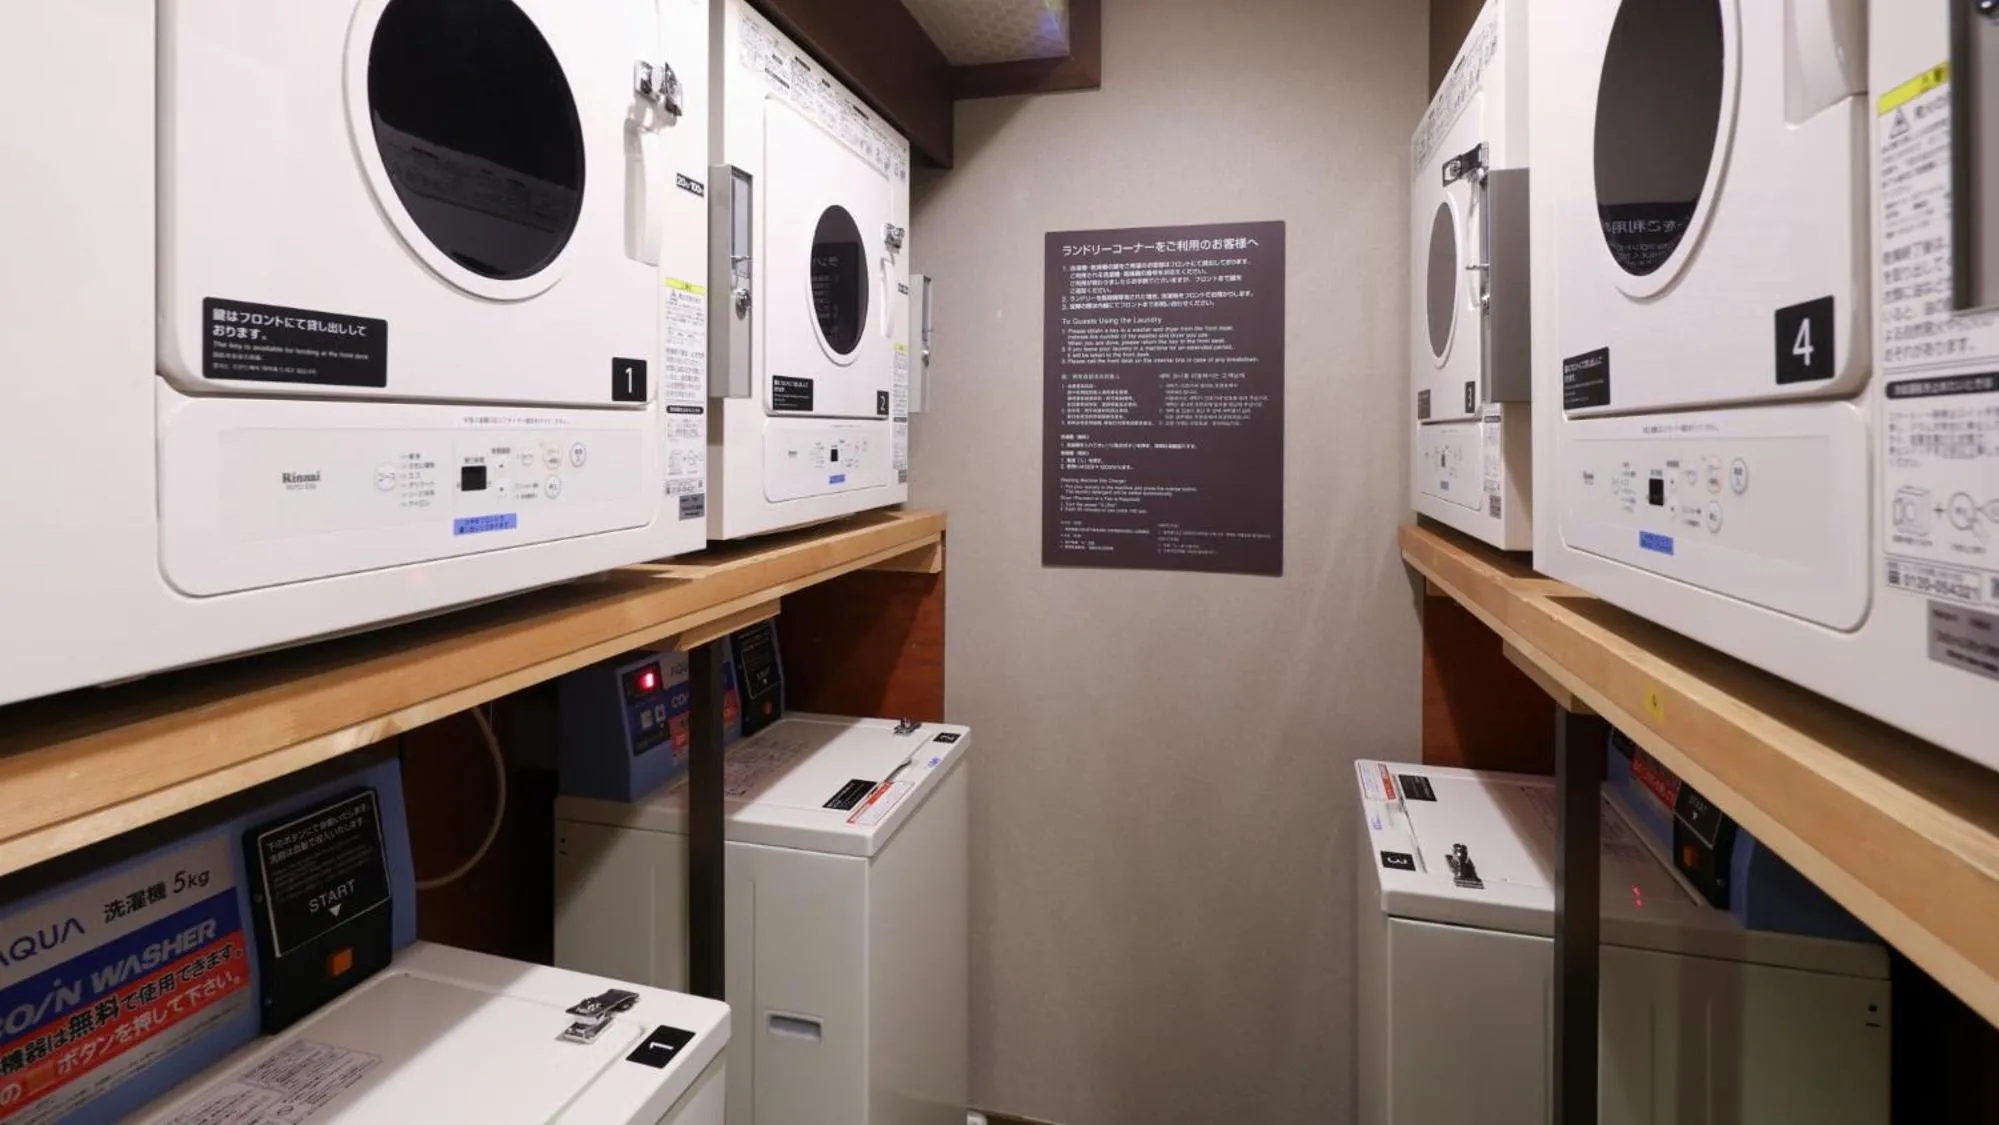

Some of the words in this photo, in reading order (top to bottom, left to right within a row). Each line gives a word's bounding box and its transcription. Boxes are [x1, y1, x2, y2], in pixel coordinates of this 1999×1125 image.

[1062, 238, 1259, 256] ランドリーコーナーをご利用のお客様へ
[212, 308, 368, 337] 鍵はフロントにて貸し出しして
[212, 325, 267, 341] おります。
[1072, 317, 1097, 325] Guests
[1099, 317, 1119, 326] Using
[1133, 316, 1162, 325] Laundry
[1792, 317, 1814, 367] 4
[625, 366, 633, 394] 1
[879, 394, 886, 412] 2
[282, 471, 320, 483] Rinnai
[104, 882, 168, 924] 洗濯機
[173, 870, 211, 893] 5kg
[309, 879, 357, 913] START
[91, 917, 218, 1000] WASHER
